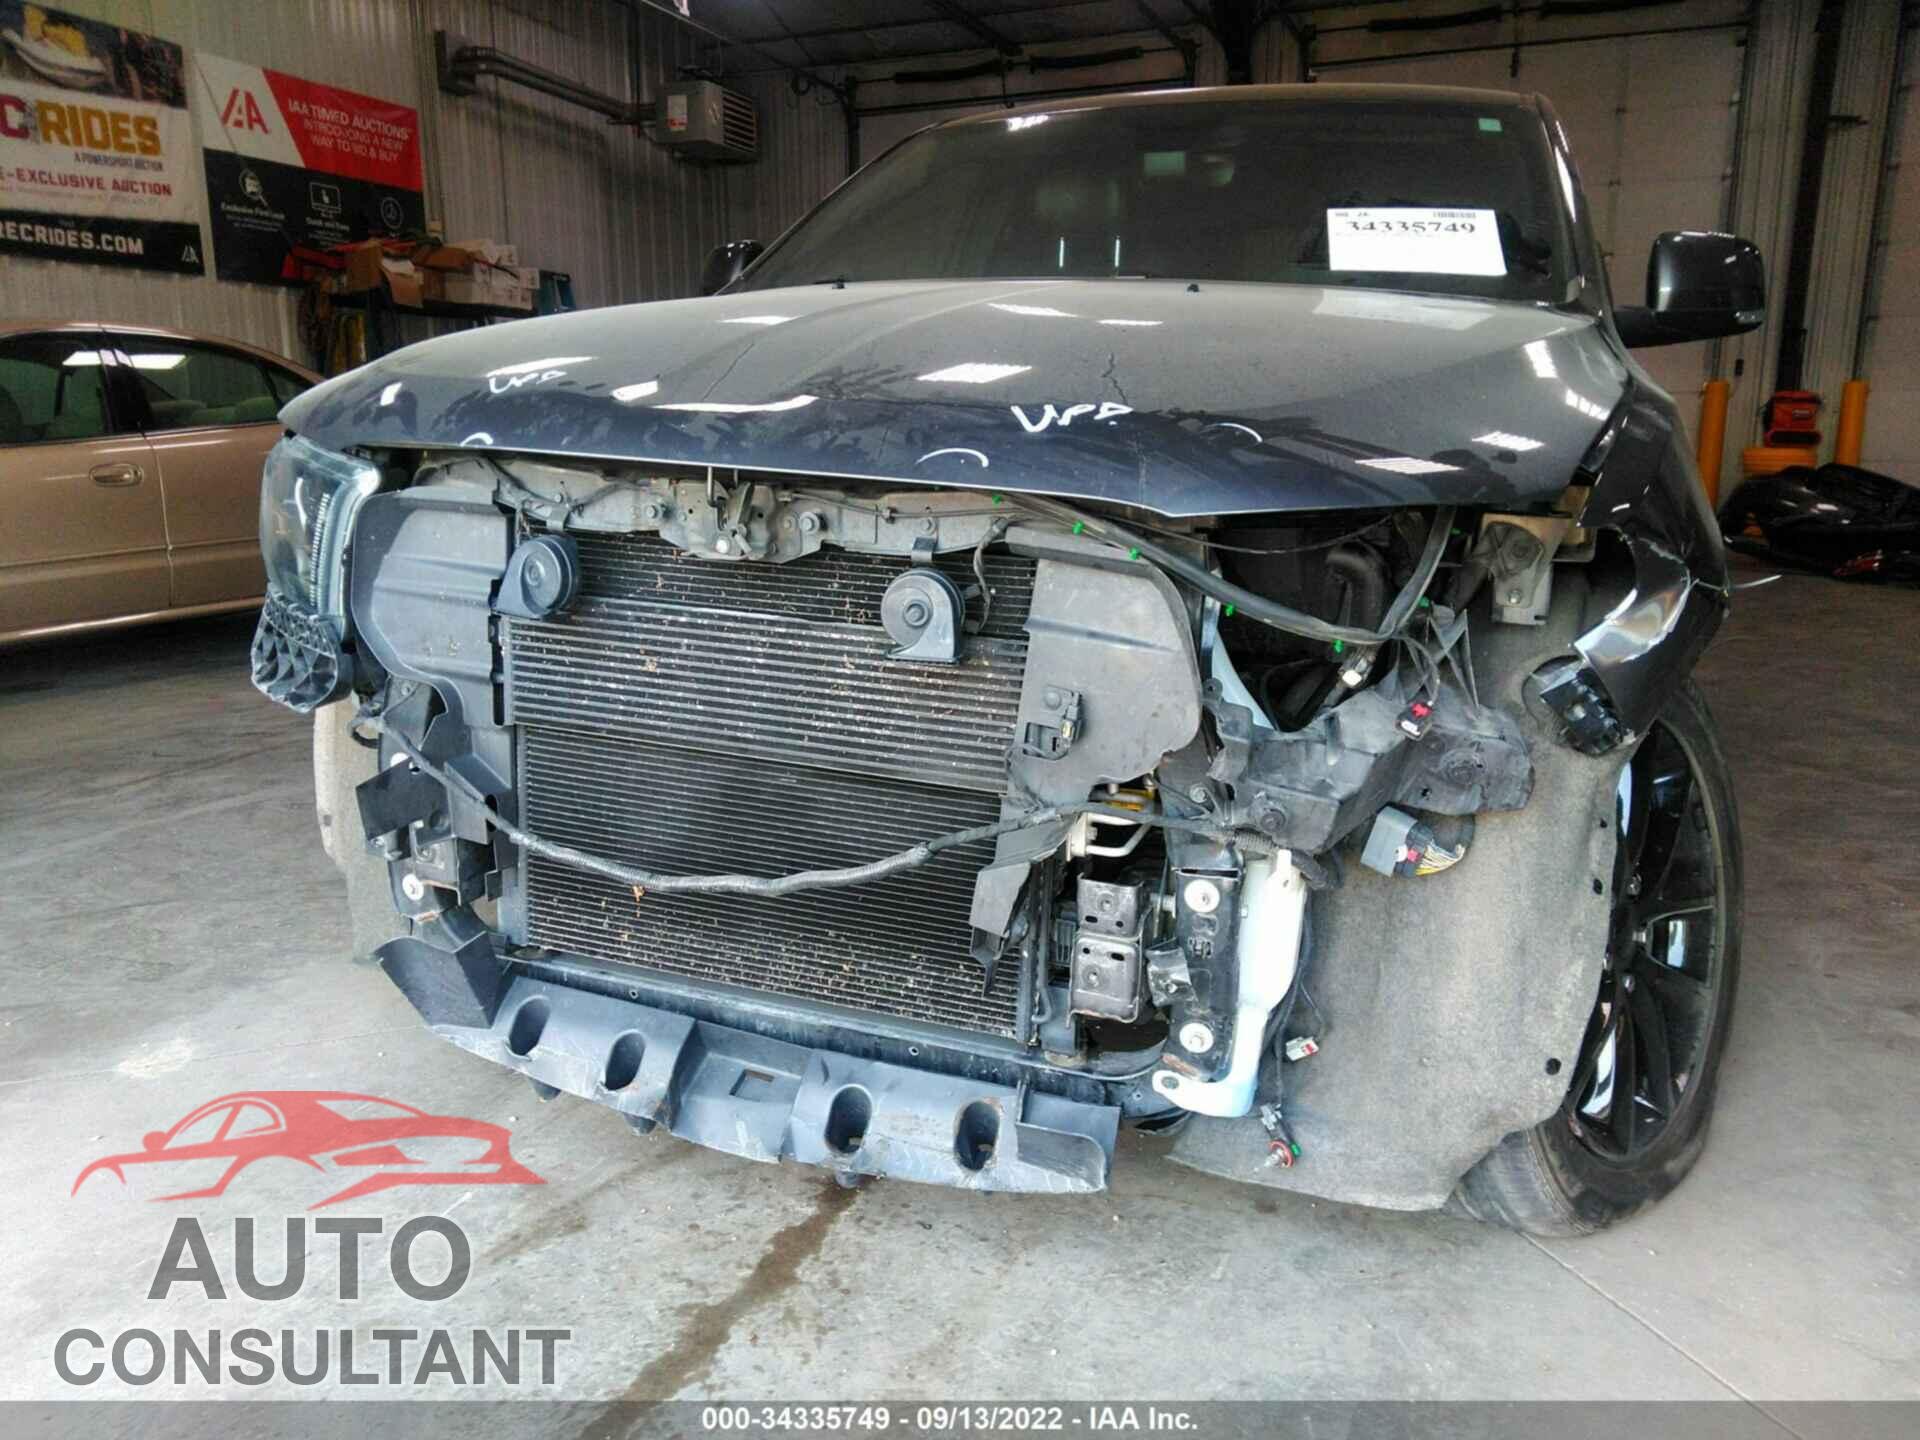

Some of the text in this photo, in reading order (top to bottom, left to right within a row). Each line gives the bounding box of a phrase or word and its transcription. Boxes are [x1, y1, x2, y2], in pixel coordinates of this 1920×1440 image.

[288, 98, 310, 116] IAA
[310, 105, 349, 125] TIMED
[36, 99, 161, 156] RIDES
[303, 117, 370, 144] INTRODUCING
[381, 136, 402, 151] NEW
[311, 133, 334, 147] WAY
[336, 137, 351, 152] TO
[378, 148, 401, 162] BUY
[111, 178, 173, 197] AUCTION
[1346, 220, 1476, 234] 34335749
